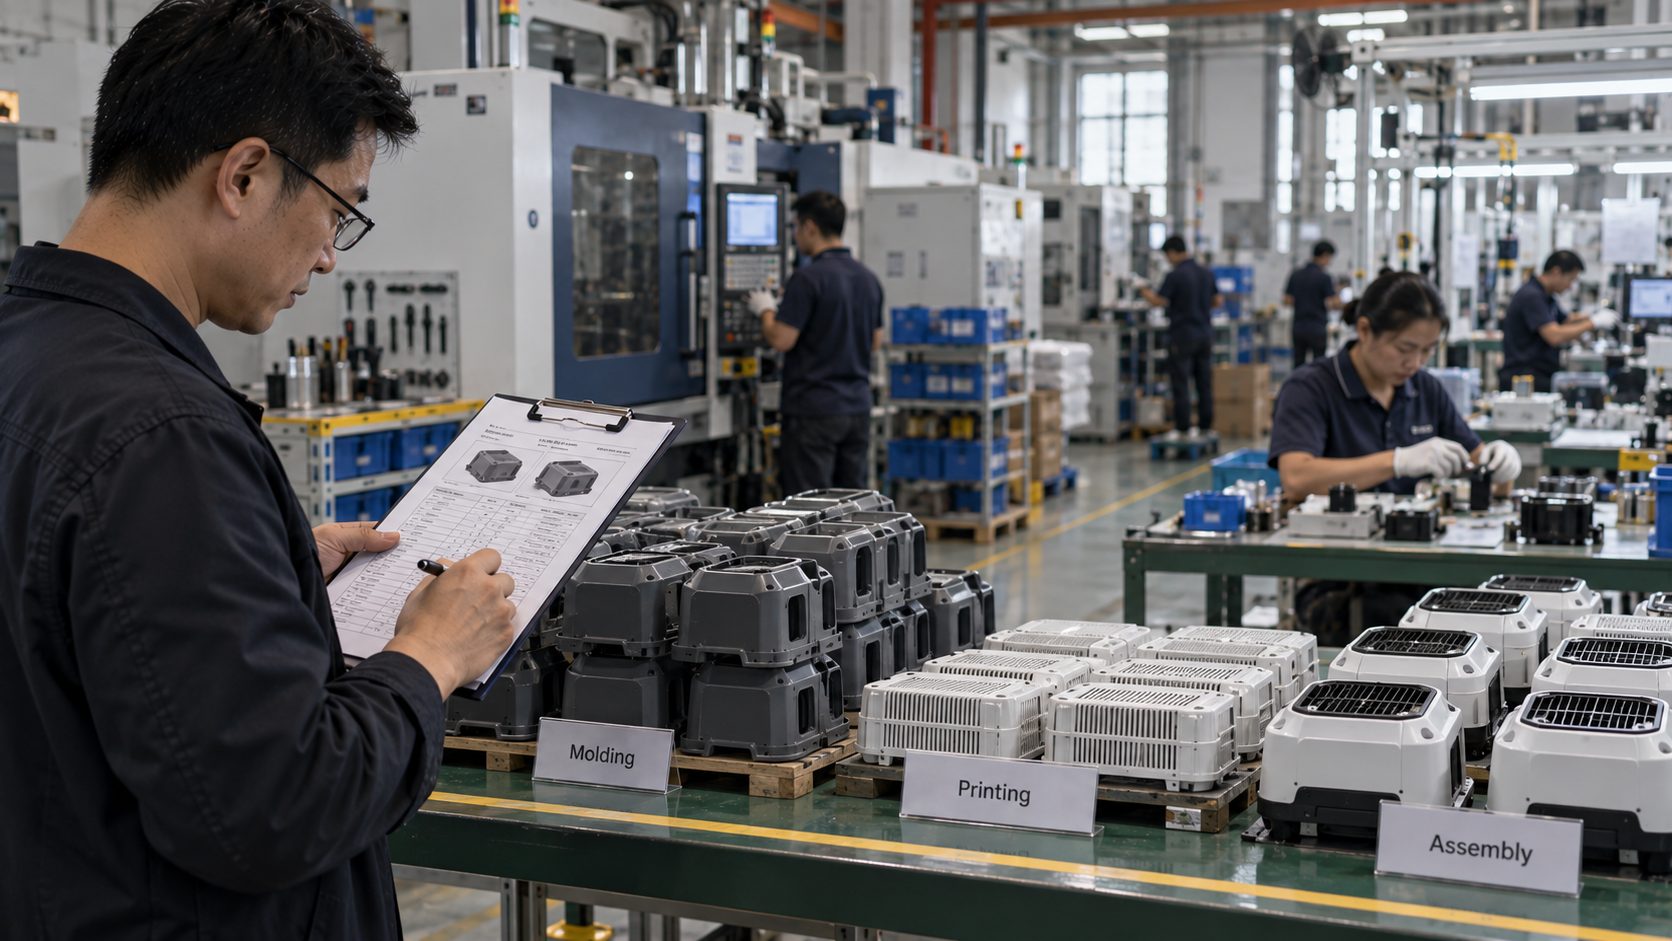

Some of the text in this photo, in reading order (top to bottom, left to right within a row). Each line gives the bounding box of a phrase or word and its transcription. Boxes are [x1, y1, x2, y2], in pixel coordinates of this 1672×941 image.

[569, 743, 635, 769] Molding
[958, 780, 1031, 807] Printing
[1429, 834, 1533, 867] Assembly
